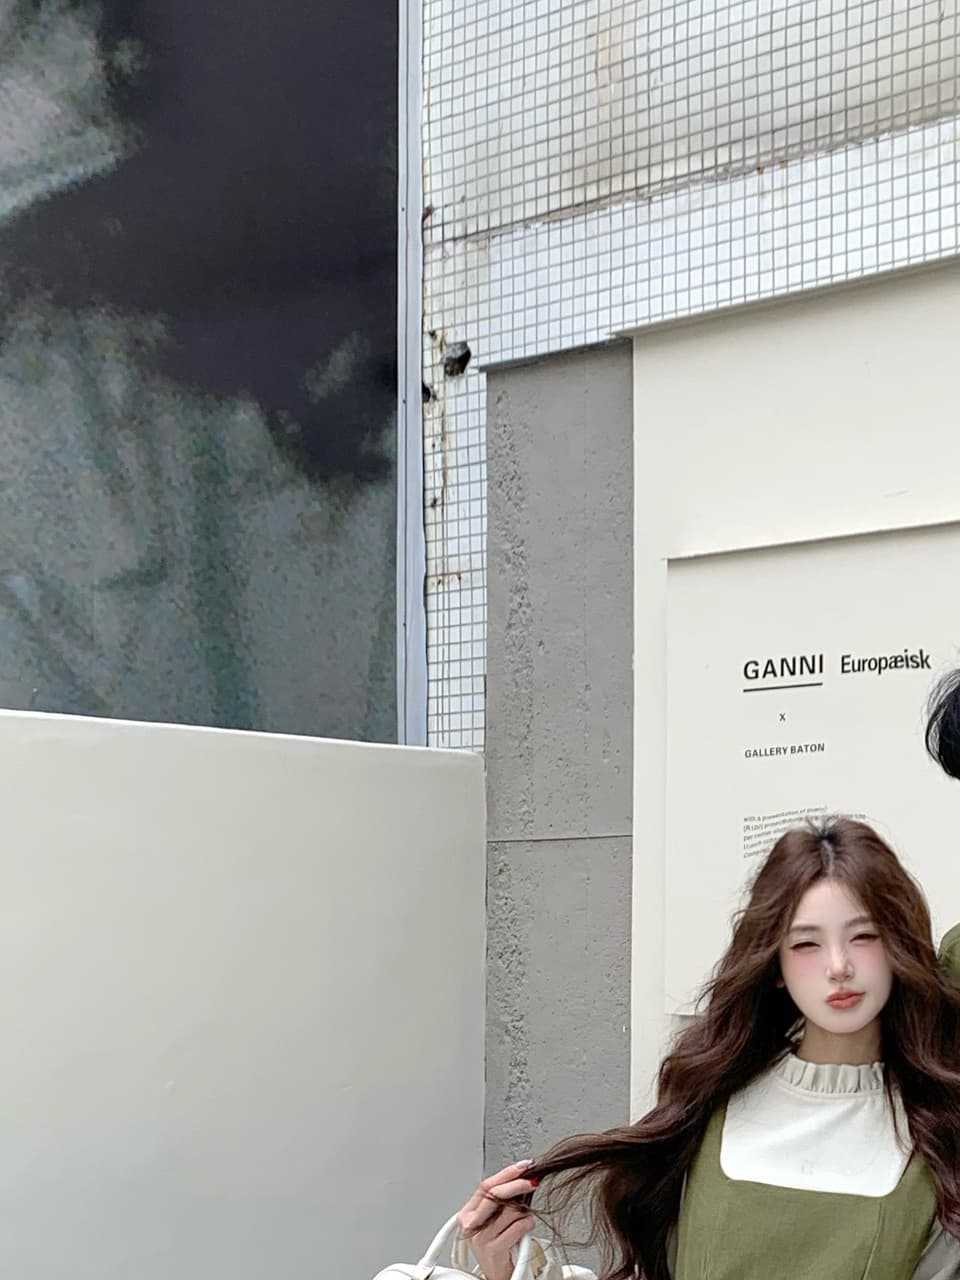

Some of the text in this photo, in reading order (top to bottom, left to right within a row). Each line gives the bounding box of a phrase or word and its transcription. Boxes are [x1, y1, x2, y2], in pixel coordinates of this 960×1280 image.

[743, 648, 932, 680] GANNI Europæisk
[744, 743, 825, 759] GALLERY BATON
